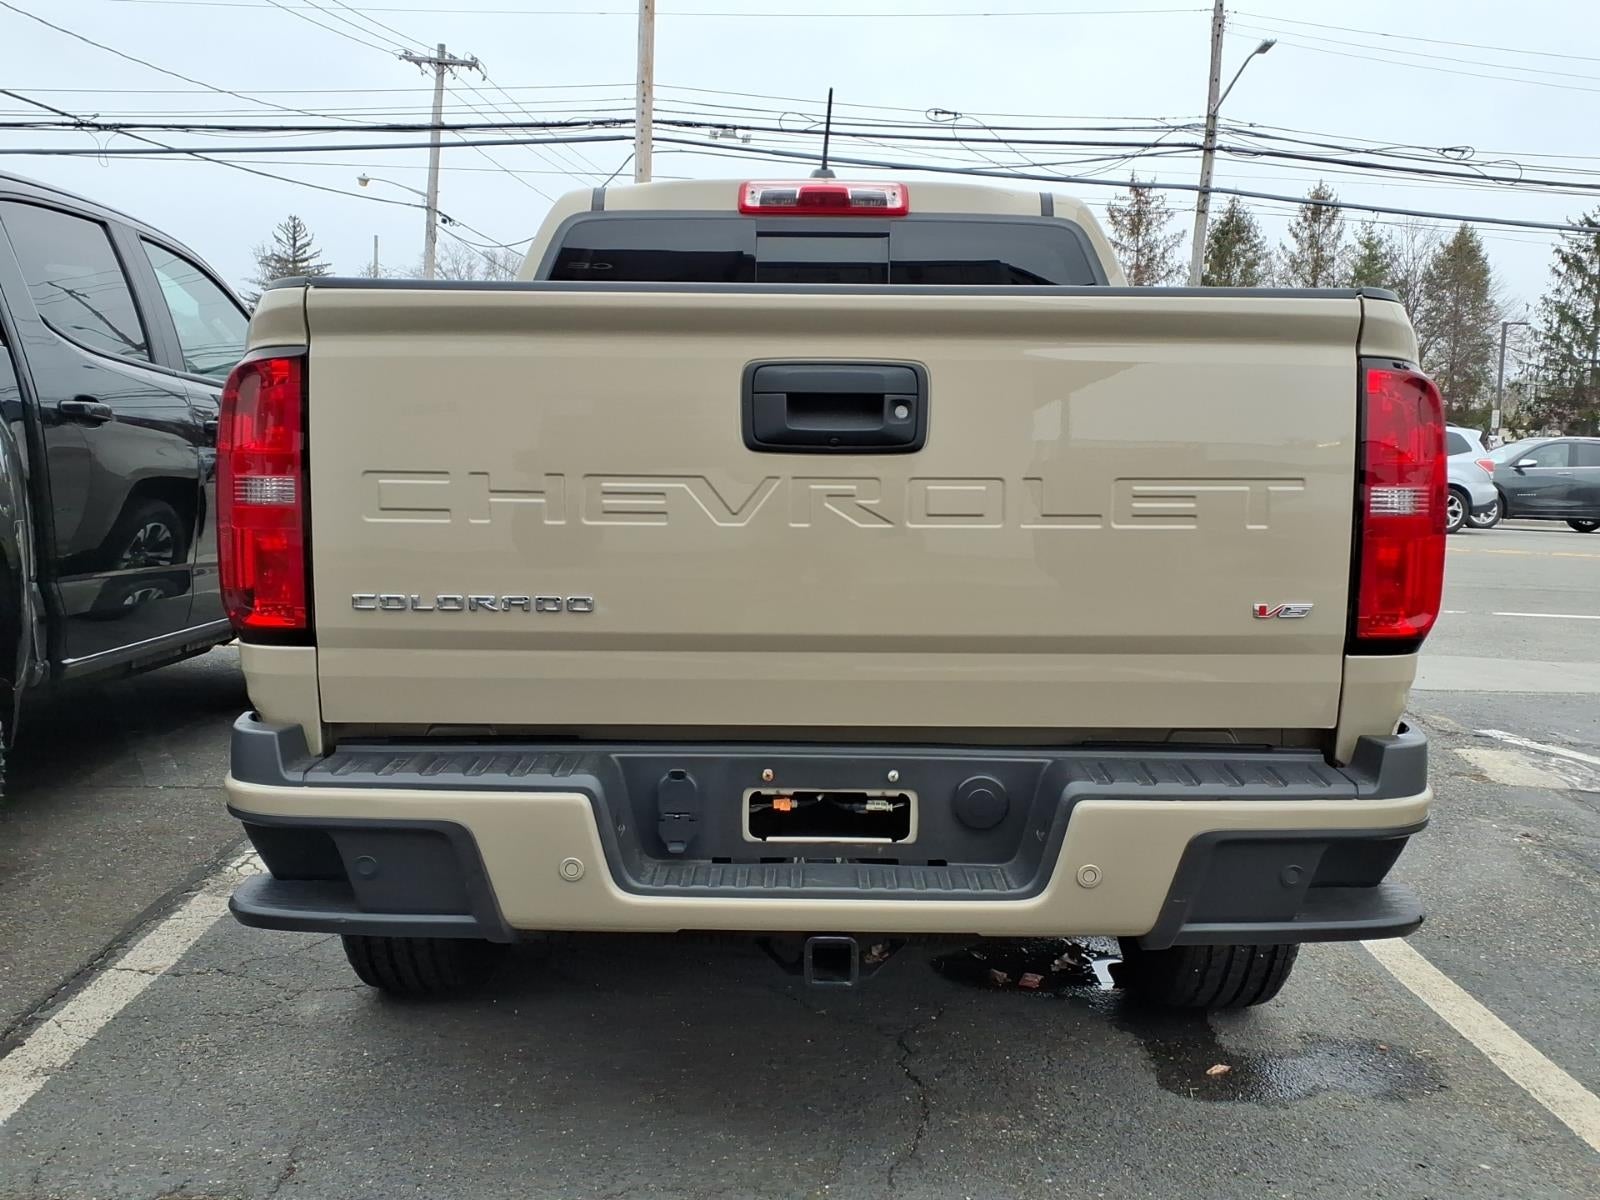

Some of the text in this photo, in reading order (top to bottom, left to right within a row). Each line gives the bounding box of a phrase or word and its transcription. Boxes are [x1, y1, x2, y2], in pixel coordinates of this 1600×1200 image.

[361, 470, 1305, 529] CHEVROLET
[351, 593, 595, 613] COLORADO
[1253, 603, 1314, 618] V6
